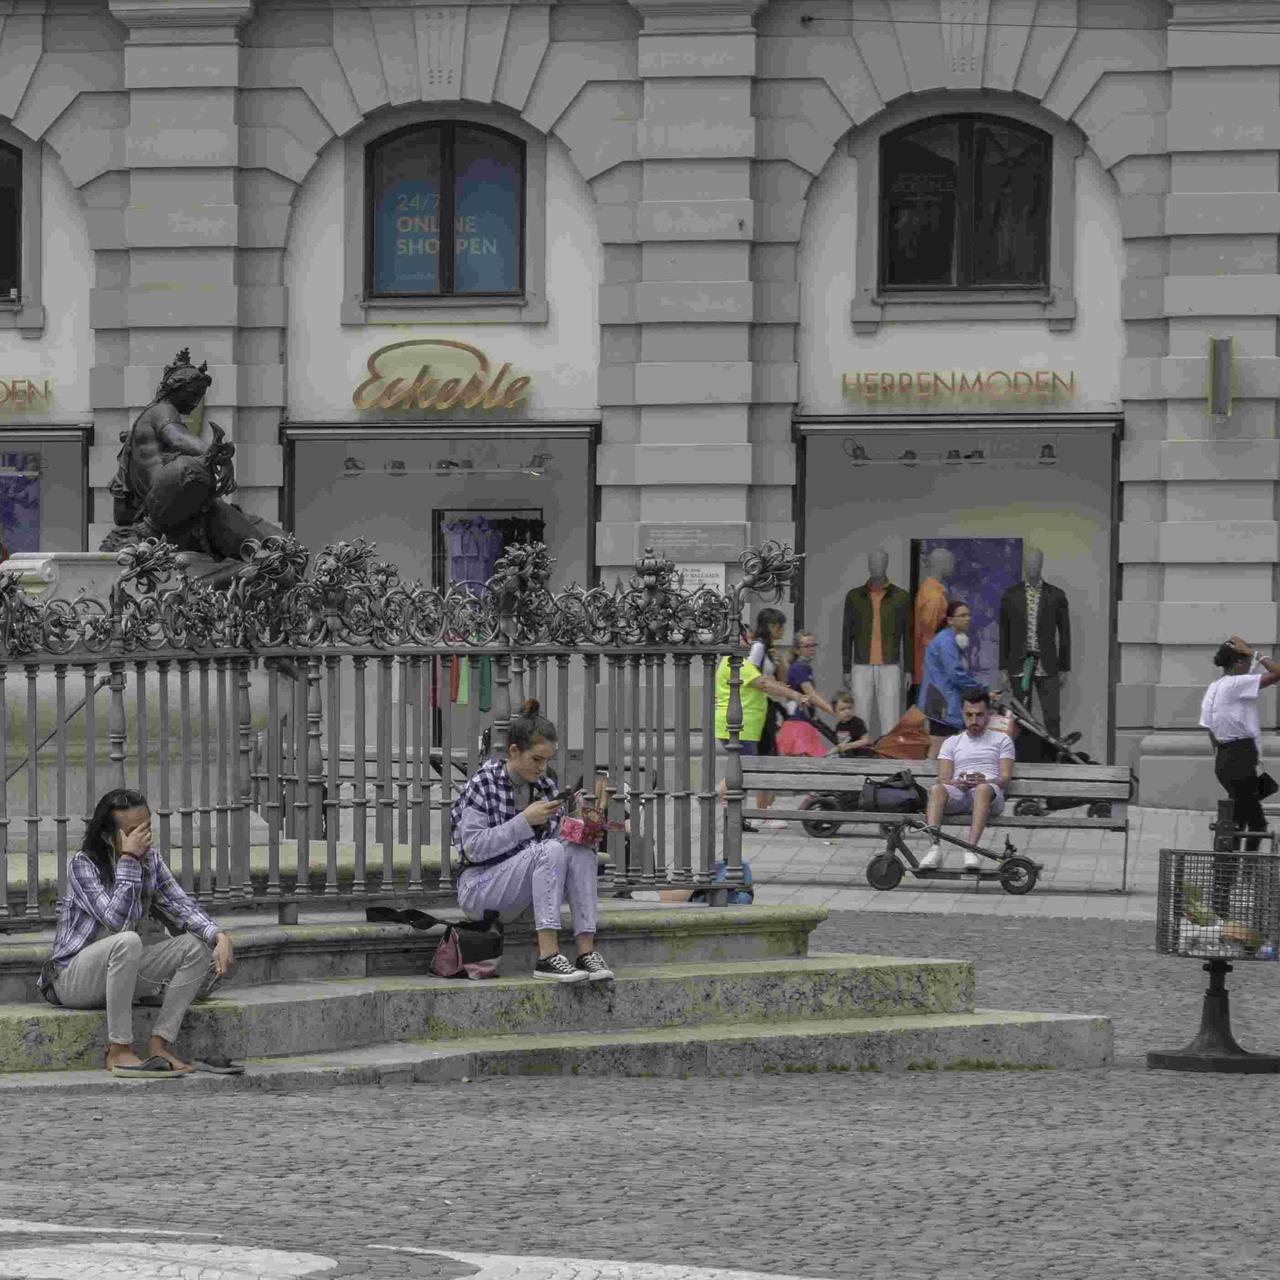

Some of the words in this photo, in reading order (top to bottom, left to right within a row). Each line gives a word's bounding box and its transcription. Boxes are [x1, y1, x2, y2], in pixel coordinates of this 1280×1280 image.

[397, 215, 477, 233] ONLNE
[397, 238, 497, 256] SHOPEN
[352, 339, 531, 410] Eckerle
[842, 370, 1075, 398] HERRENMODEN
